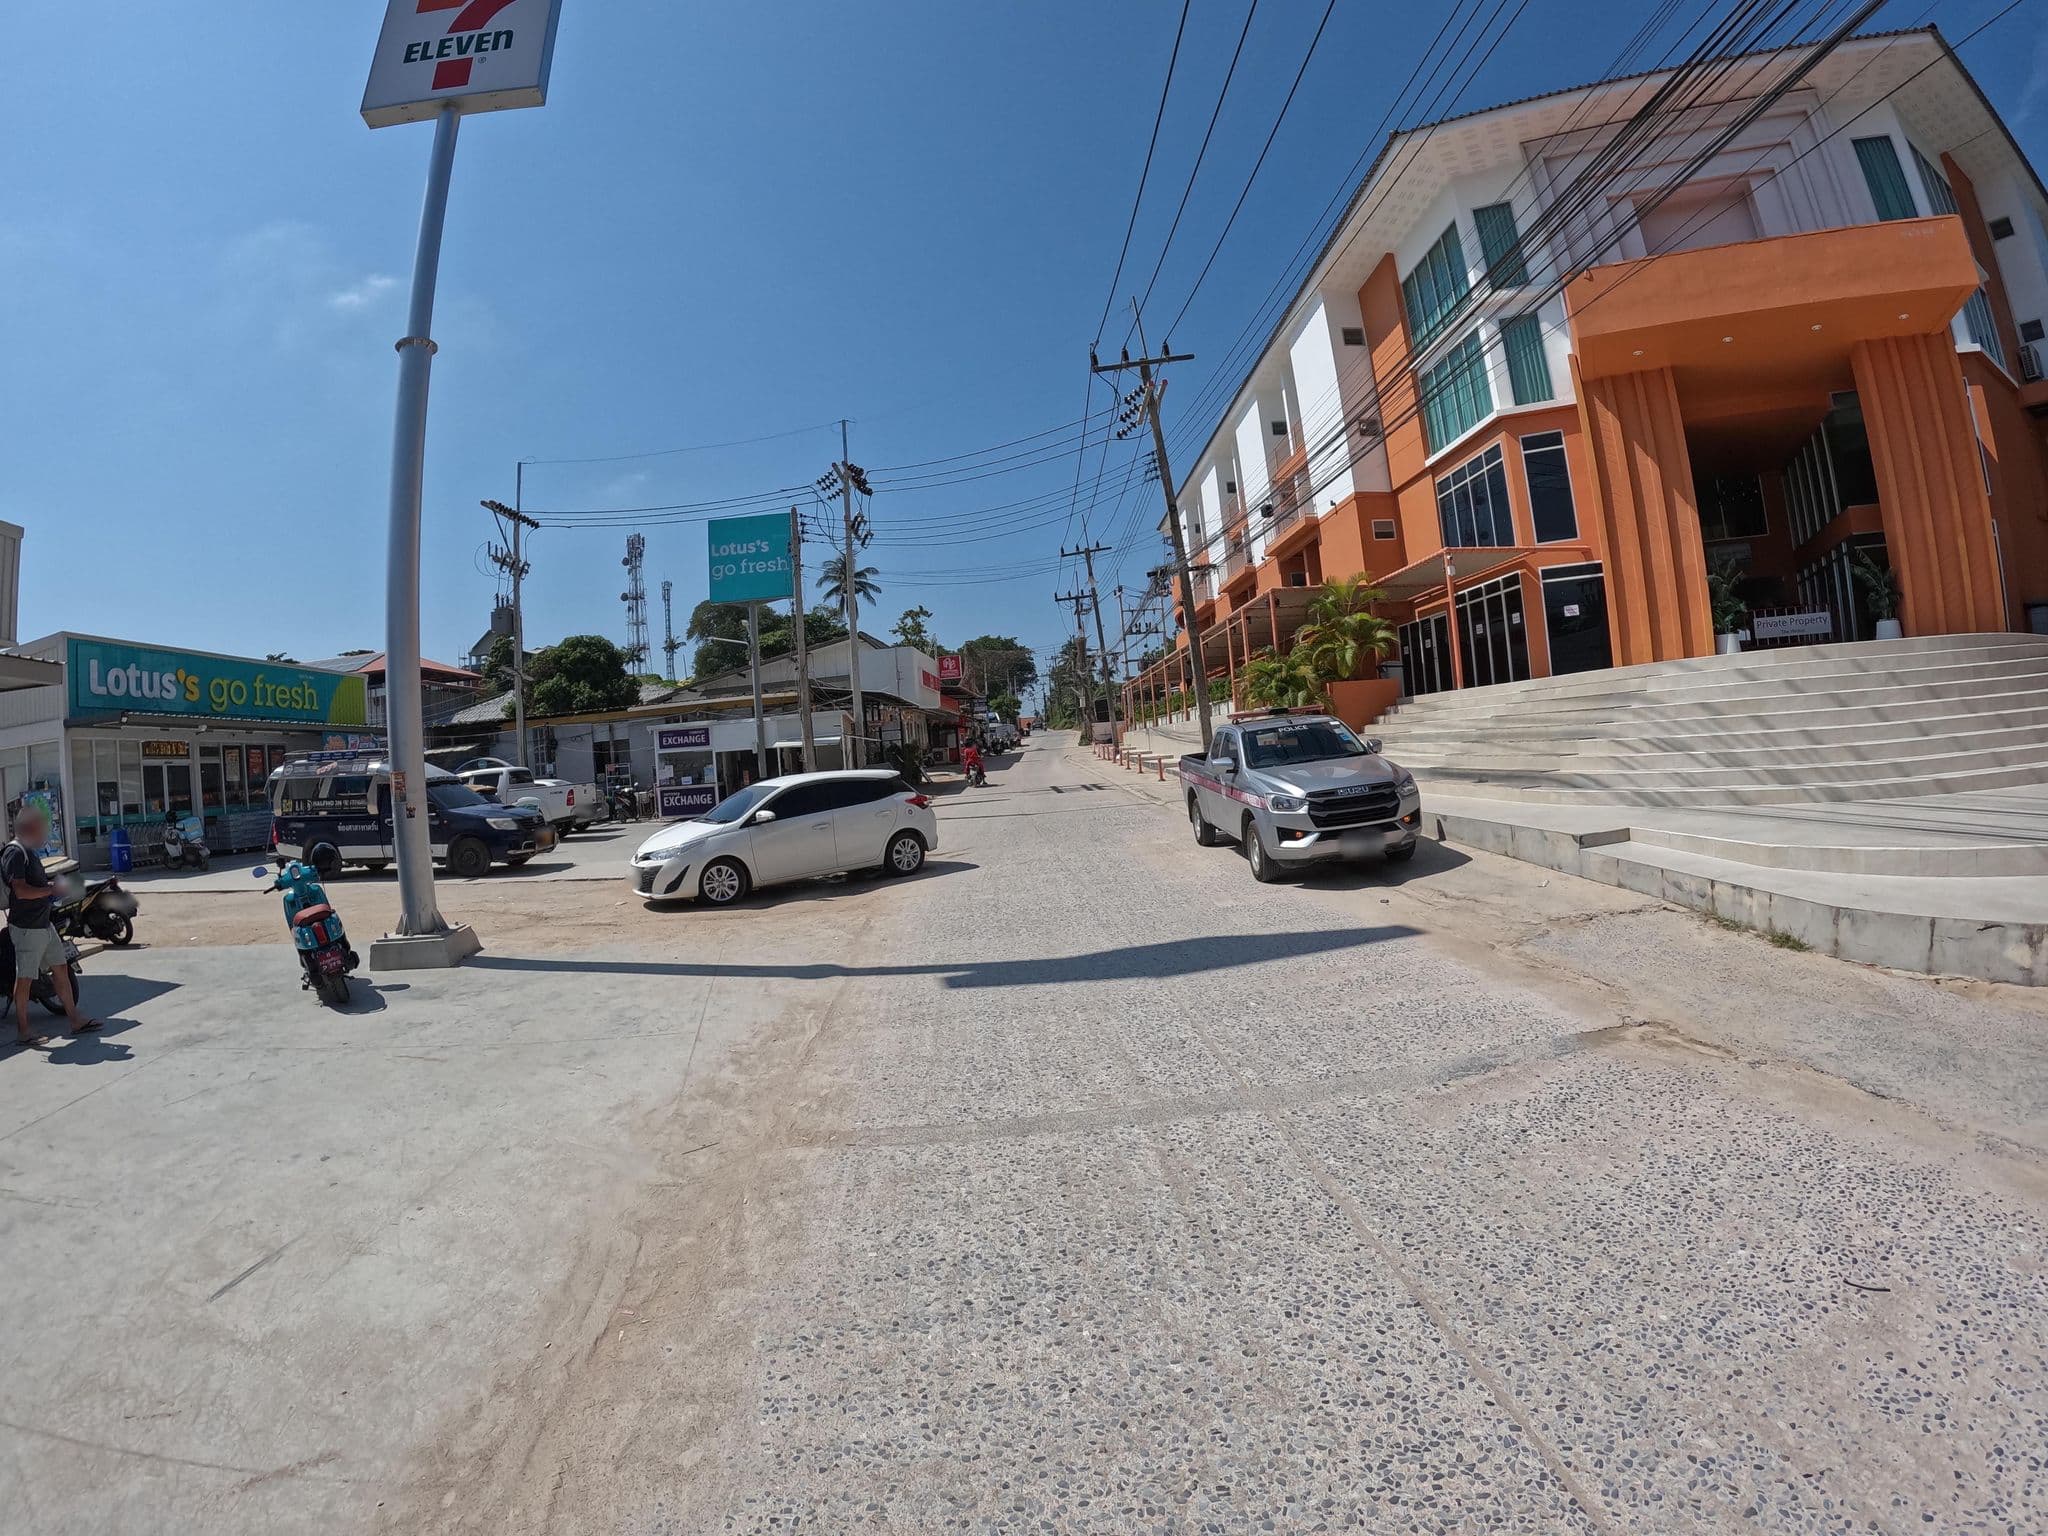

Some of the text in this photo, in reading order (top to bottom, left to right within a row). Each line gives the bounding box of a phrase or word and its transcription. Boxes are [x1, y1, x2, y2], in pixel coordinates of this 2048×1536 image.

[711, 538, 770, 558] Lotus's
[711, 556, 790, 581] go fresh
[1756, 615, 1828, 629] Private Property
[89, 658, 320, 712] Lotus's go fresh
[1278, 725, 1309, 733] POLICE
[662, 734, 706, 746] EXCHANGE
[1337, 786, 1369, 797] ISUZU
[664, 793, 713, 807] EXCHANGE
